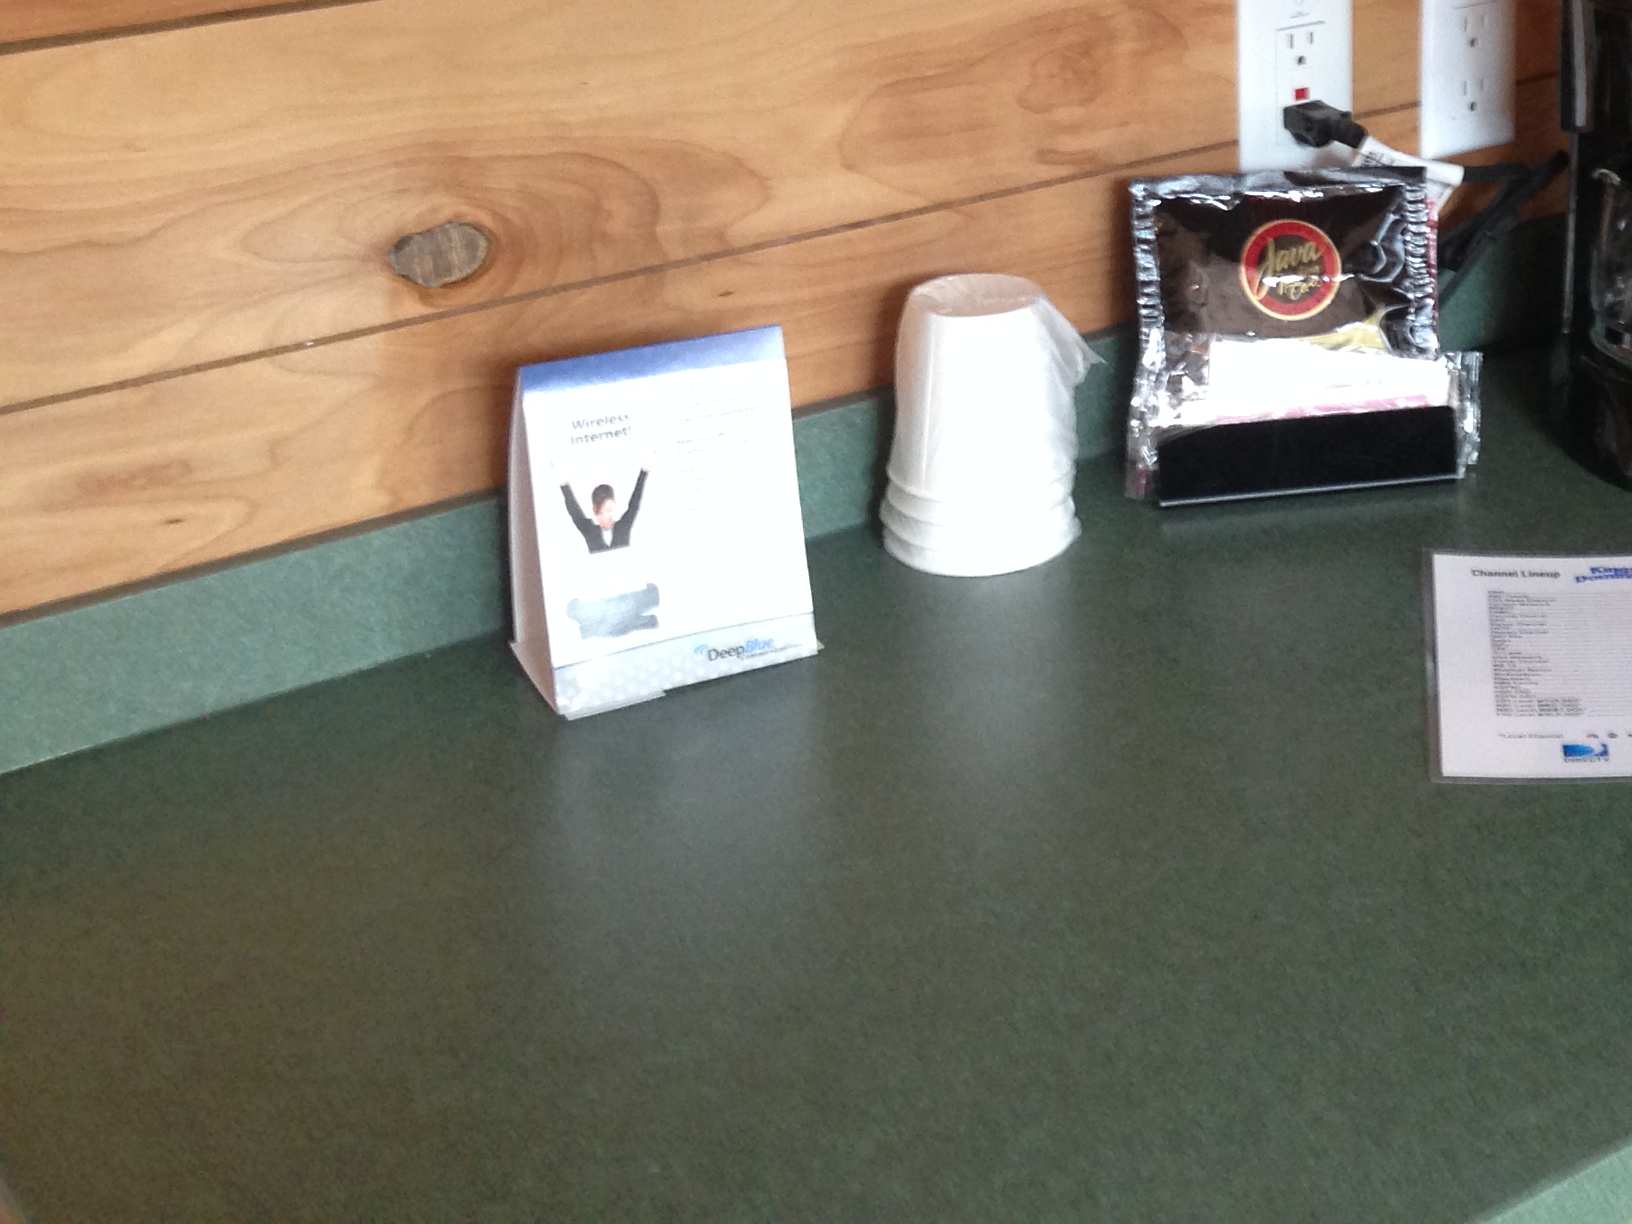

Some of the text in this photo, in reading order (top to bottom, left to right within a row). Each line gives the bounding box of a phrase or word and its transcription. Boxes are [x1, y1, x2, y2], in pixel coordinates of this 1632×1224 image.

[571, 414, 630, 430] Wireless
[570, 425, 632, 445] Internet!
[1471, 569, 1561, 579] Channel Lineup
